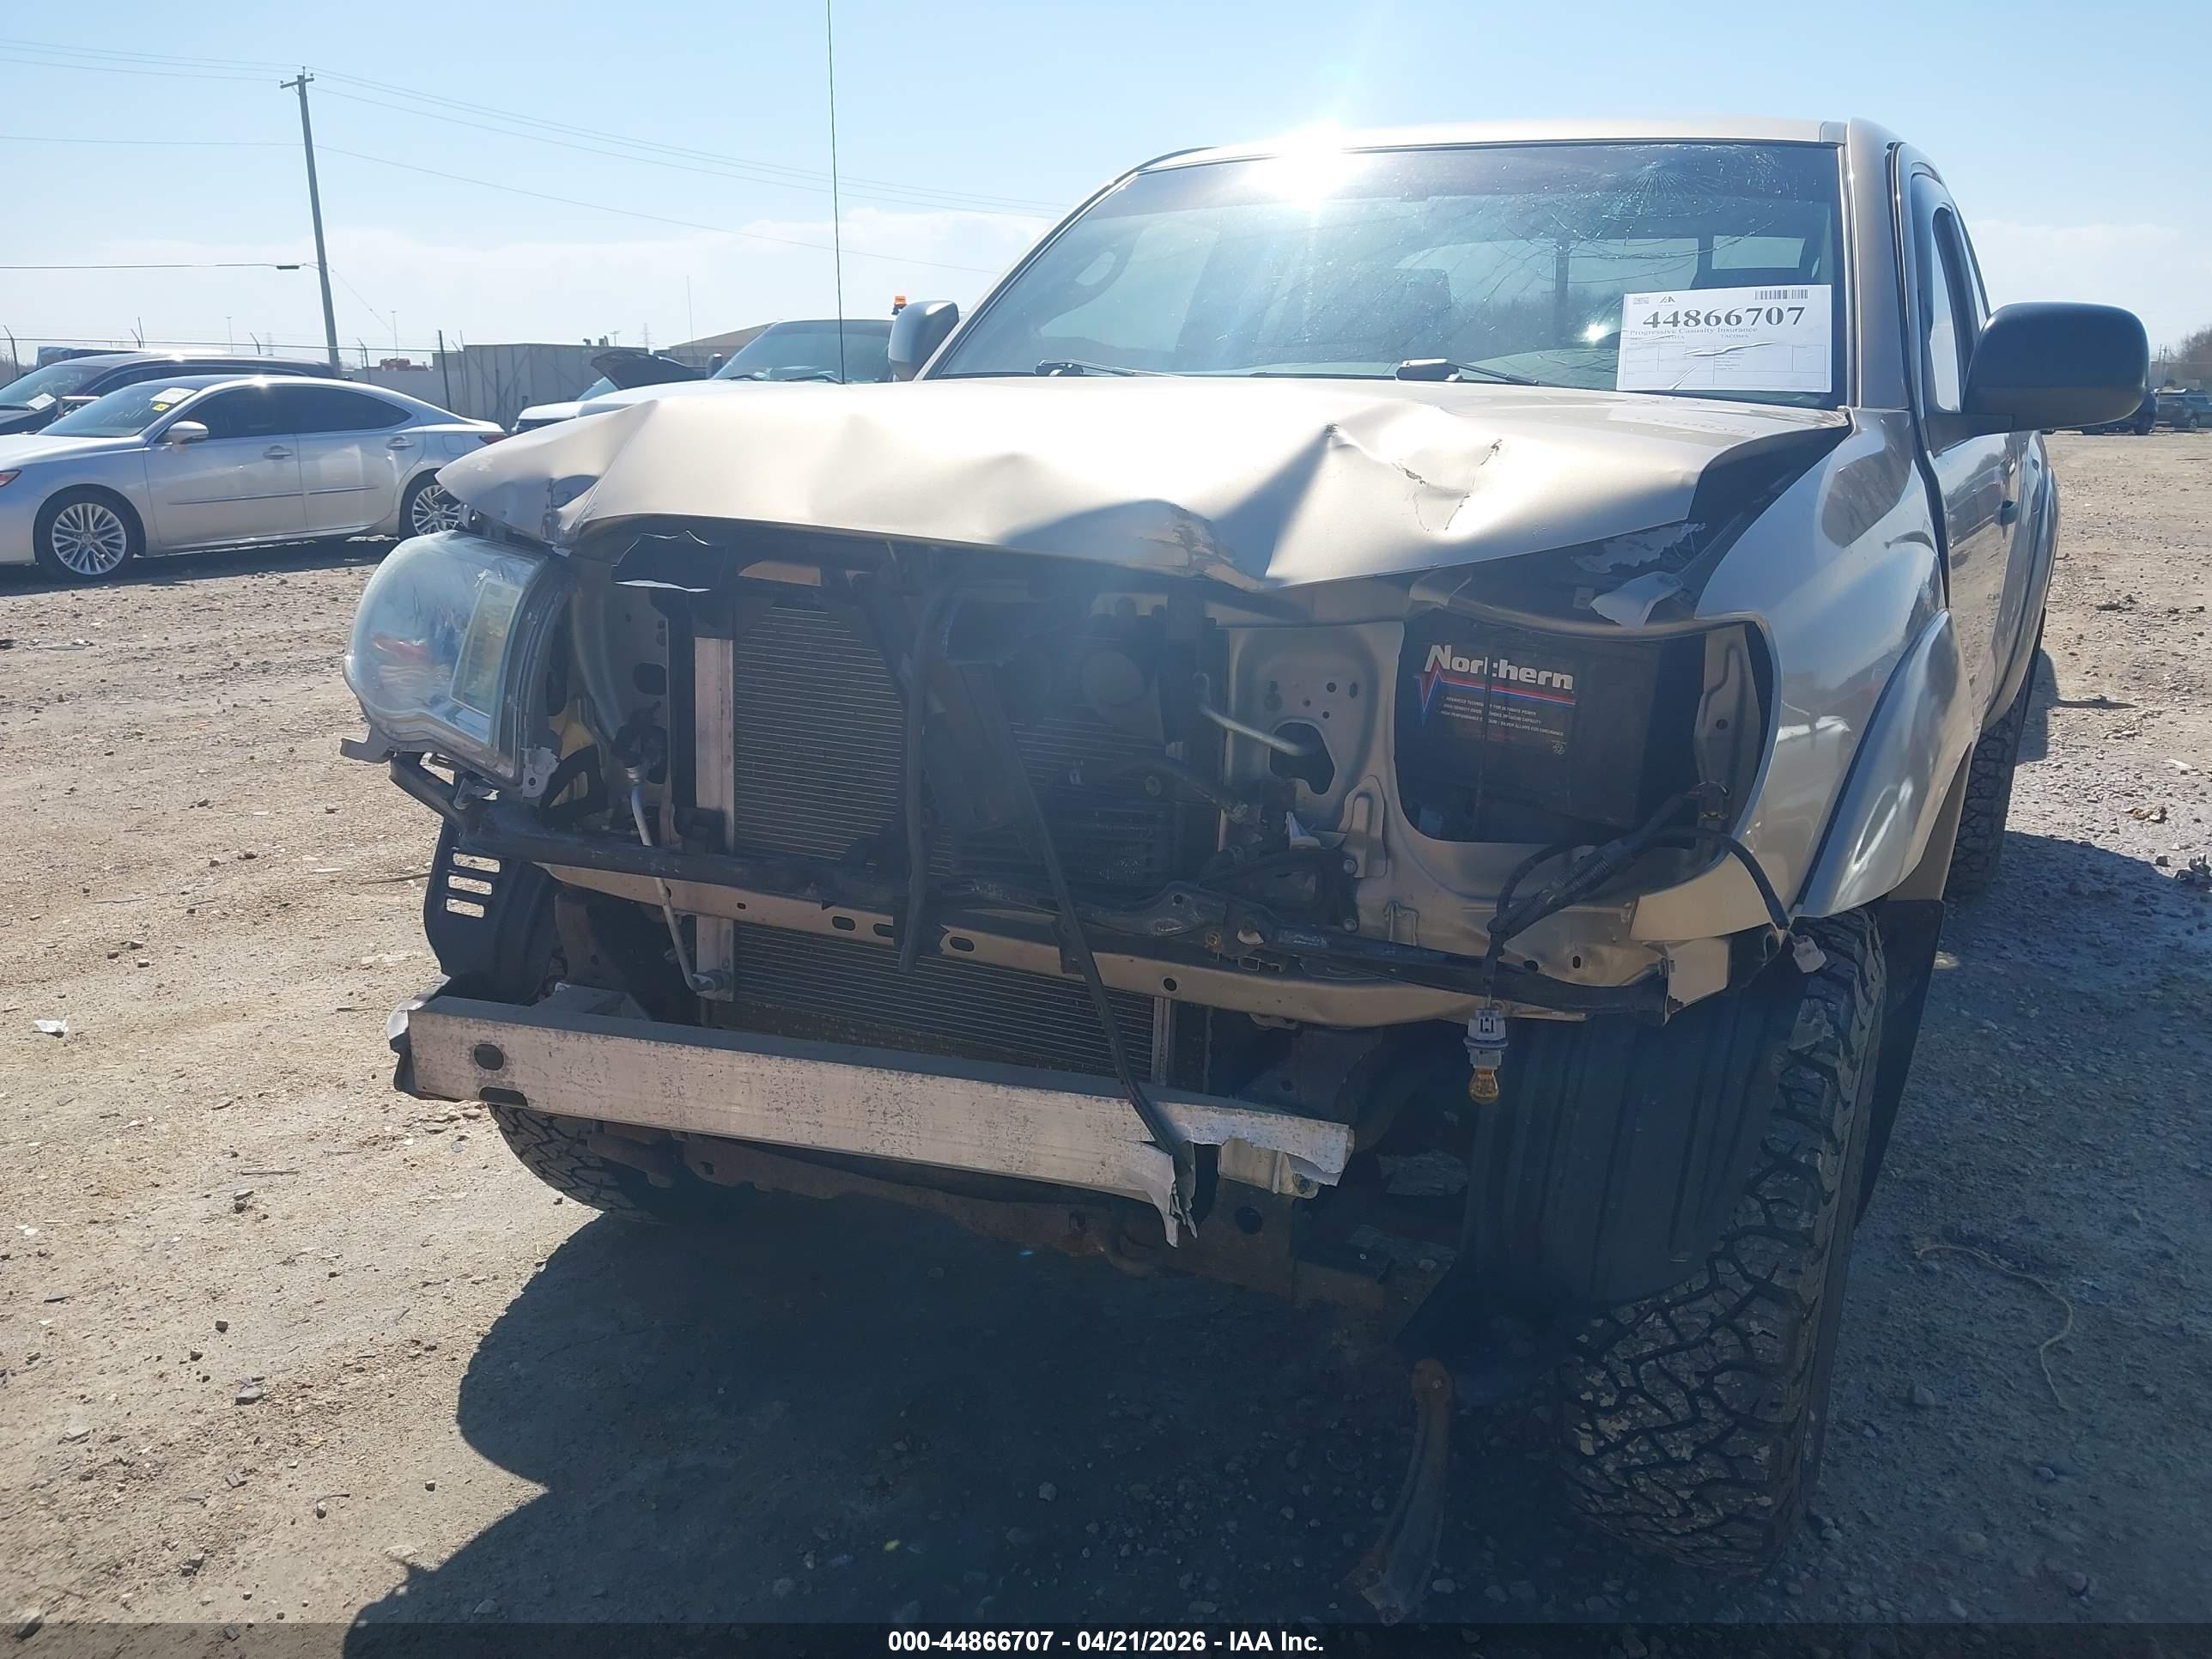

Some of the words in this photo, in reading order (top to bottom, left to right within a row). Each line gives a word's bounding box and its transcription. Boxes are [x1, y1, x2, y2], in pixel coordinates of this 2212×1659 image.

[1643, 307, 1805, 329] 44866707
[1679, 326, 1714, 335] Casualty
[1424, 645, 1574, 690] Northern
